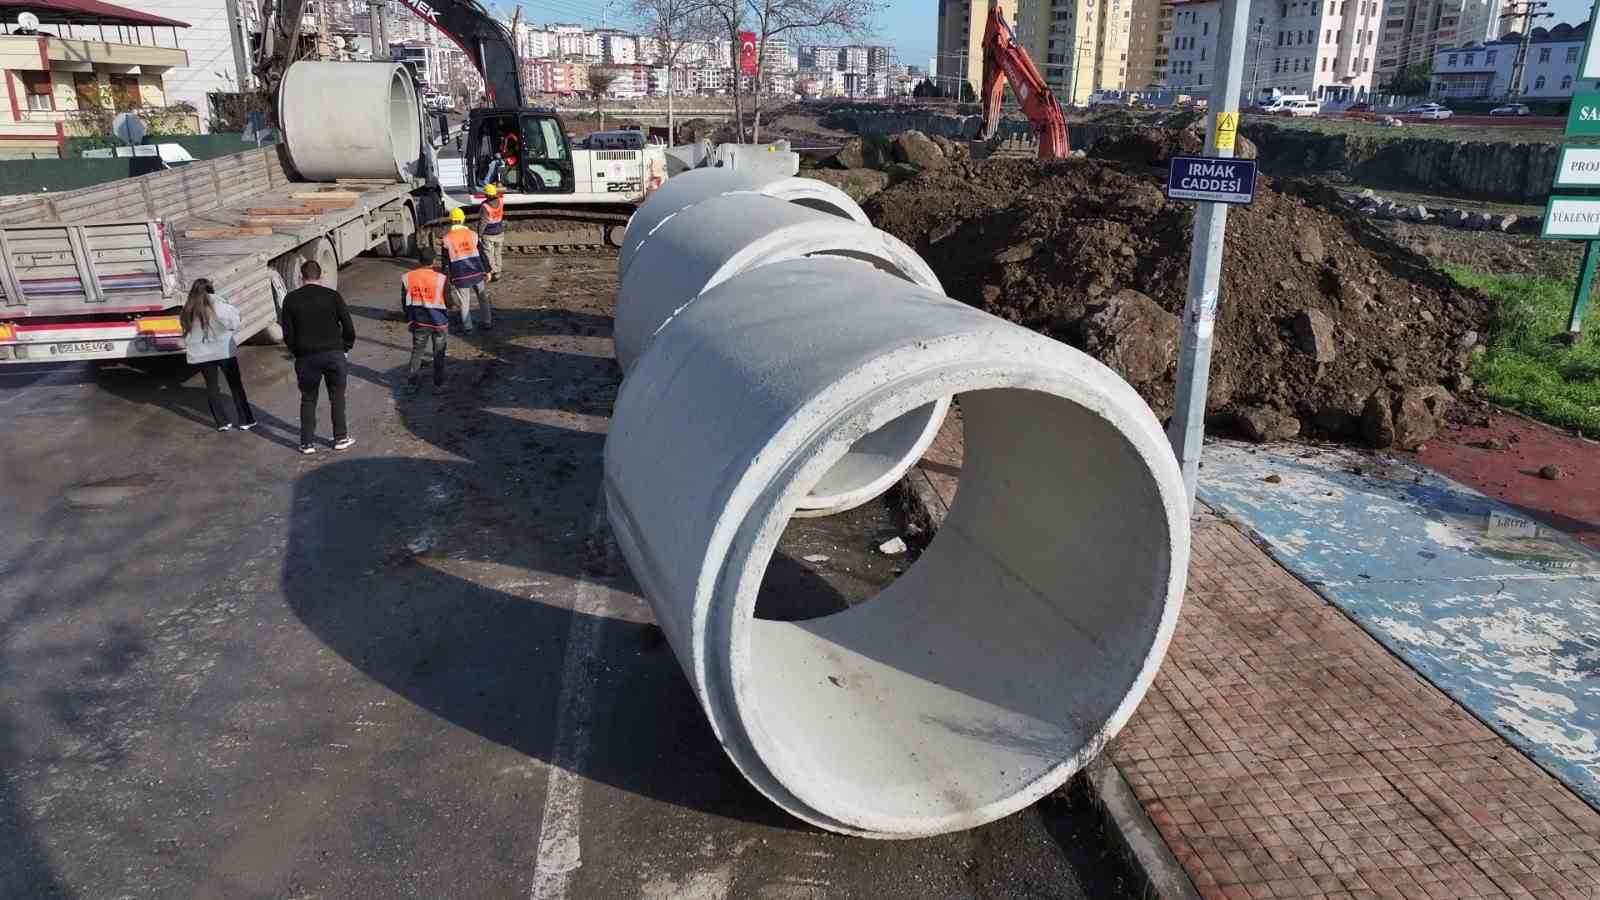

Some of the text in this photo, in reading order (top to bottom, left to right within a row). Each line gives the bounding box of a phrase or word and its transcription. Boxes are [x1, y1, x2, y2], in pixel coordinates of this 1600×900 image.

[1579, 106, 1600, 120] SA
[1188, 163, 1235, 178] IRMAK
[1181, 177, 1241, 192] CADDESİ
